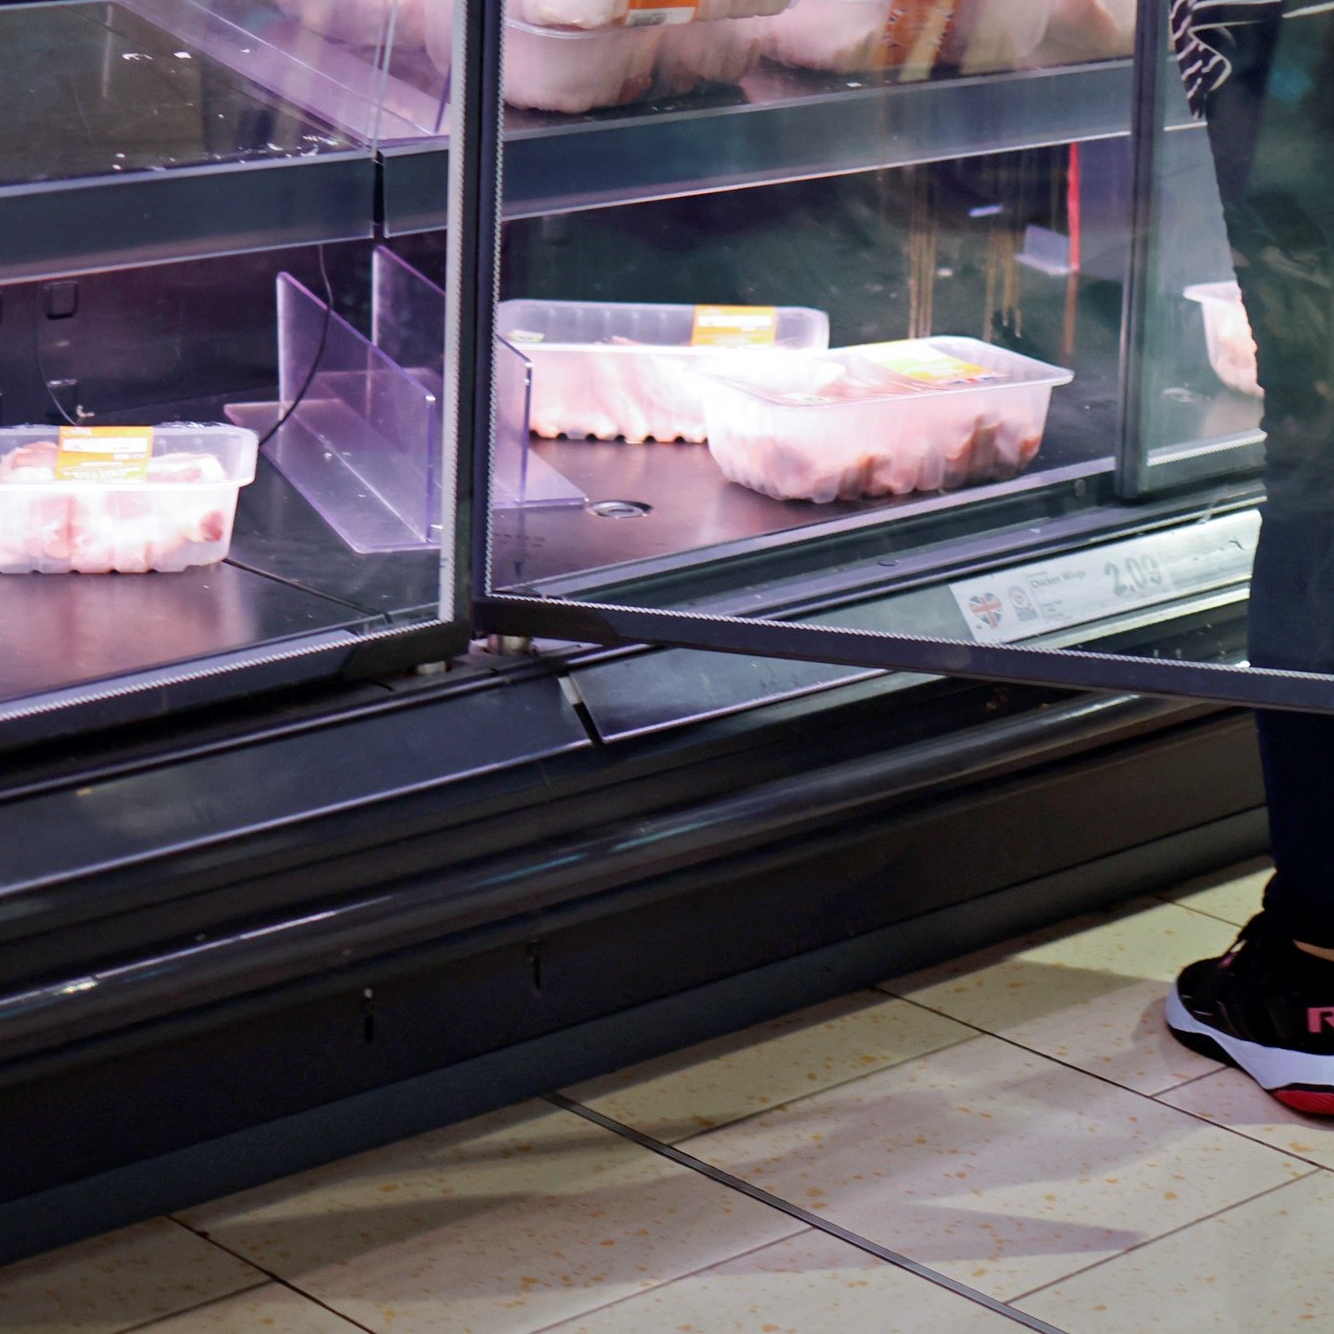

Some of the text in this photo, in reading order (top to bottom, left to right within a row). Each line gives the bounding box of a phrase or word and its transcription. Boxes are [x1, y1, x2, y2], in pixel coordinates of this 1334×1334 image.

[1030, 568, 1087, 590] Chicken Wings
[1103, 553, 1164, 596] 2.09
